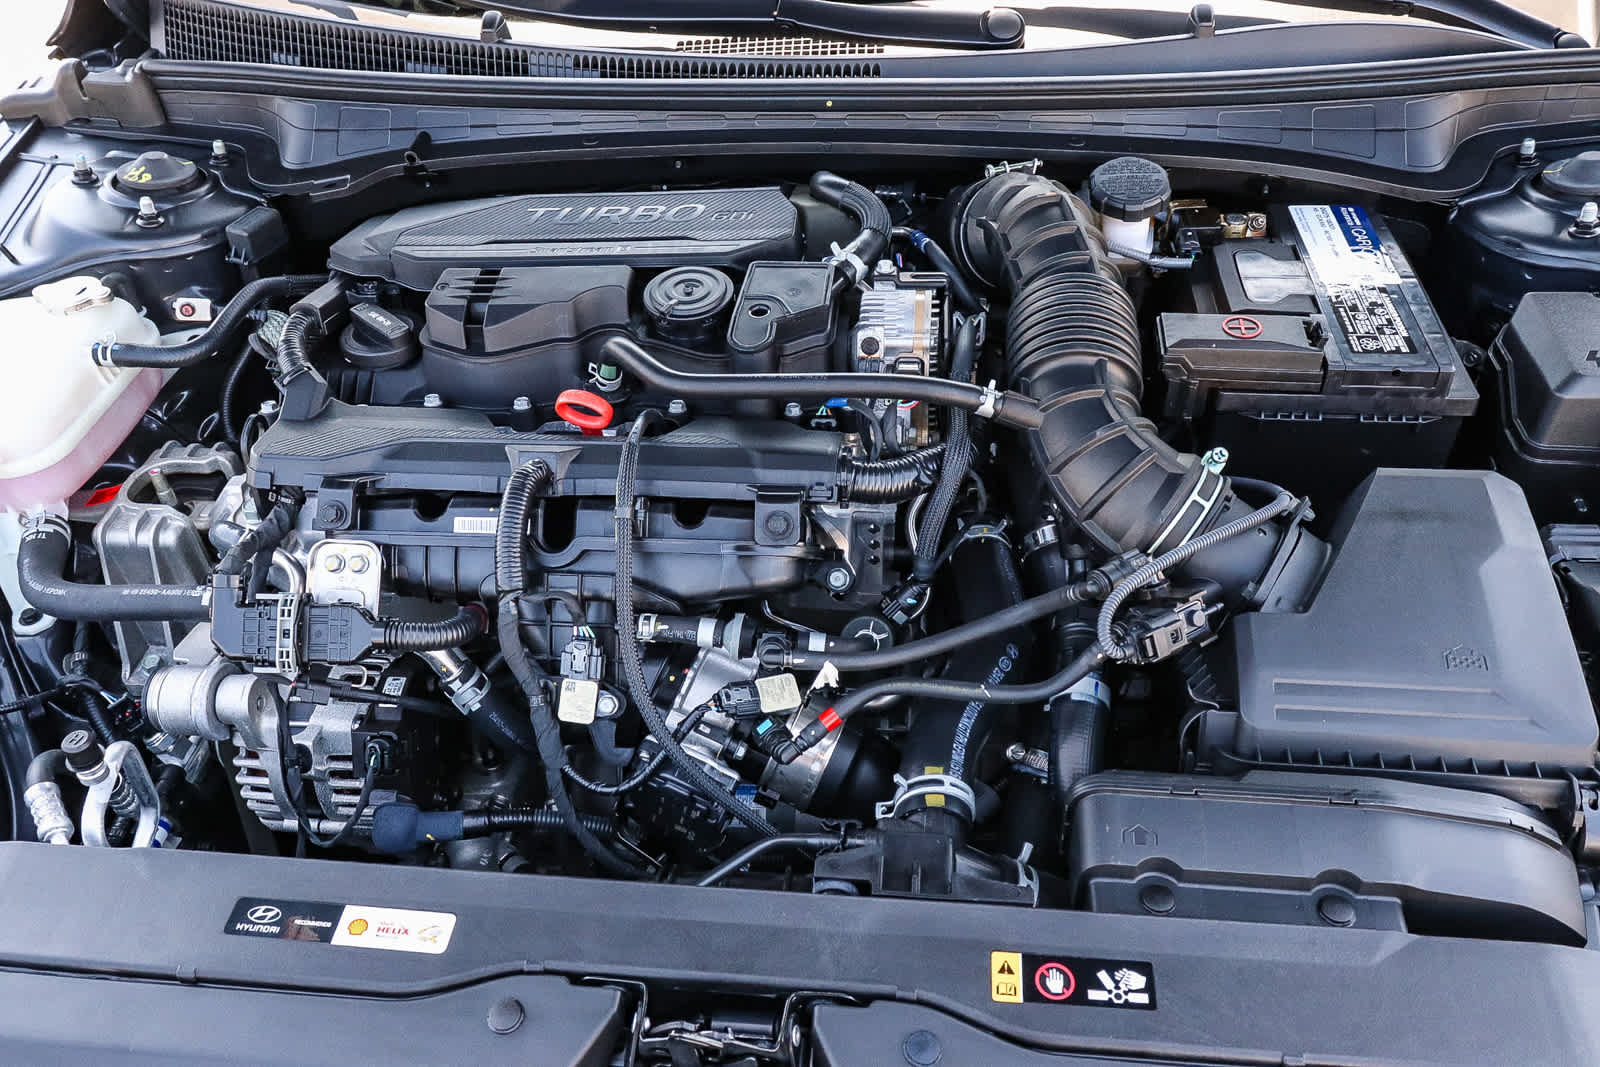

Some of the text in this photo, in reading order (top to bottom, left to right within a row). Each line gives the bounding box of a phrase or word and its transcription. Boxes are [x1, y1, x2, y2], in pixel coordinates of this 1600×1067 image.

[527, 203, 705, 225] TURBO
[235, 922, 280, 934] HYUNDAI
[376, 926, 409, 935] HELIX
